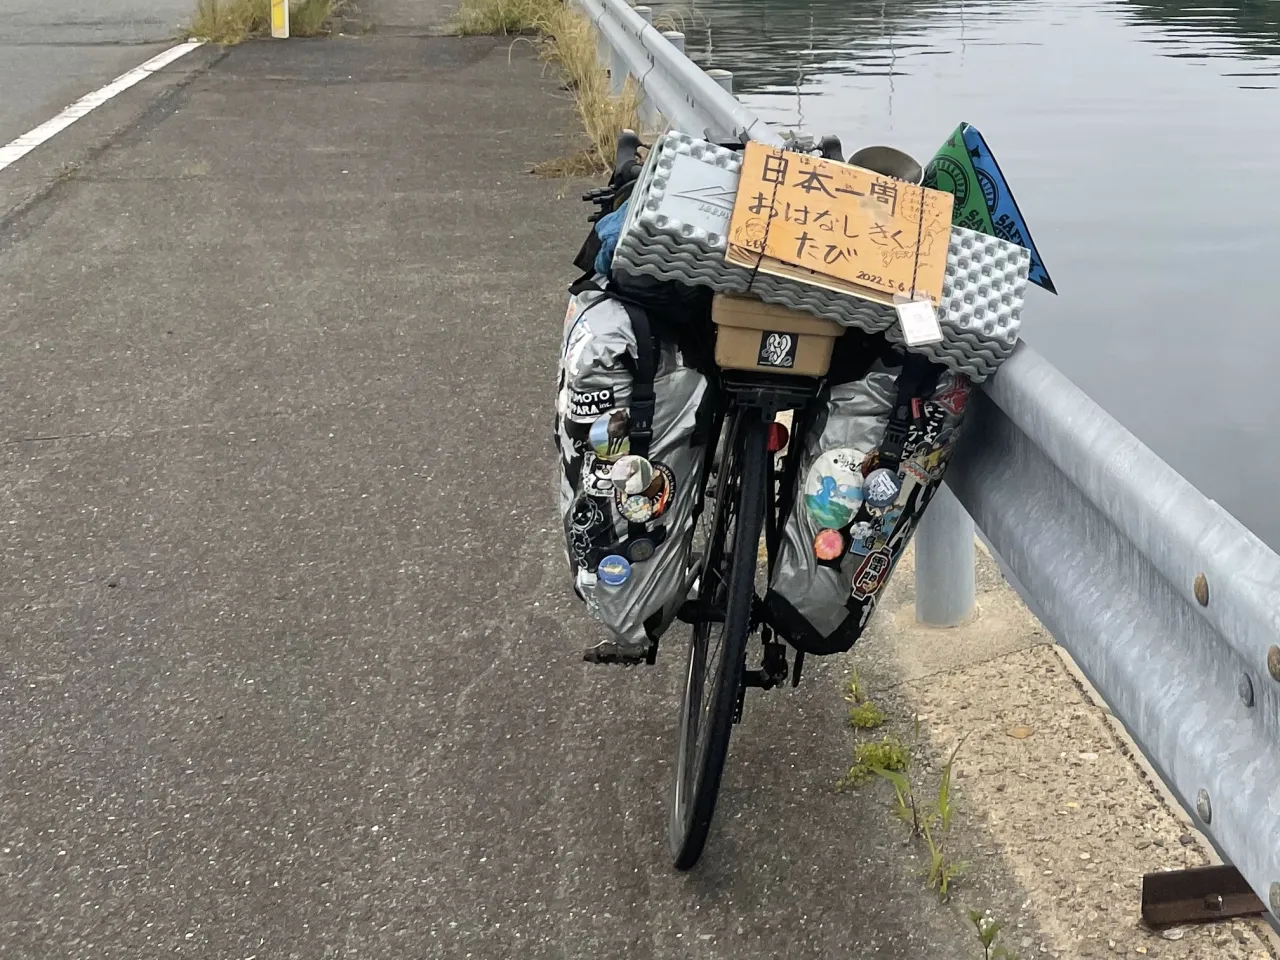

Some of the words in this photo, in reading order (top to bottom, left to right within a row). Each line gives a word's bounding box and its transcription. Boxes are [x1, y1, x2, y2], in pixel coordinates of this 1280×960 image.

[761, 154, 898, 218] 日本一周
[793, 230, 858, 265] たび
